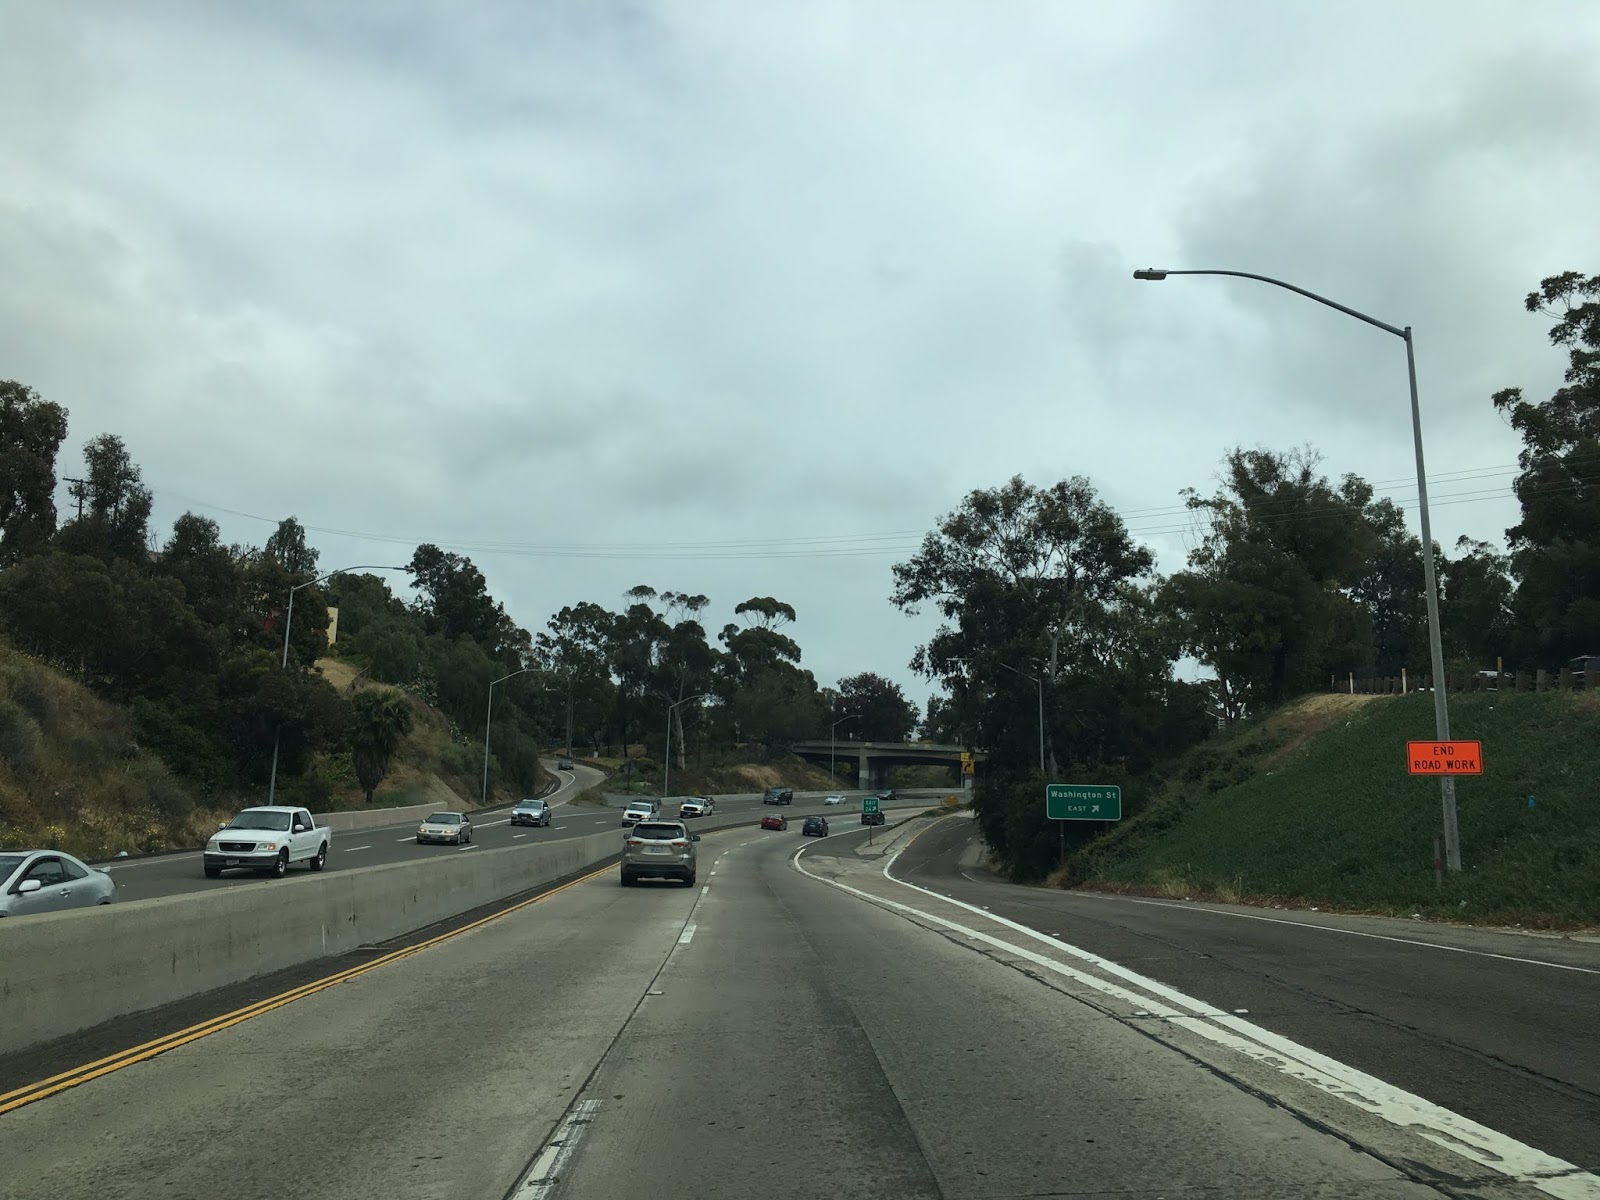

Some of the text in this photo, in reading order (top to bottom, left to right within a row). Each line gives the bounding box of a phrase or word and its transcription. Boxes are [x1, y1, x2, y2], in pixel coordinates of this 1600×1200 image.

[1433, 746, 1454, 756] END
[1414, 760, 1476, 769] ROAD WORK
[1051, 790, 1117, 800] Washington St
